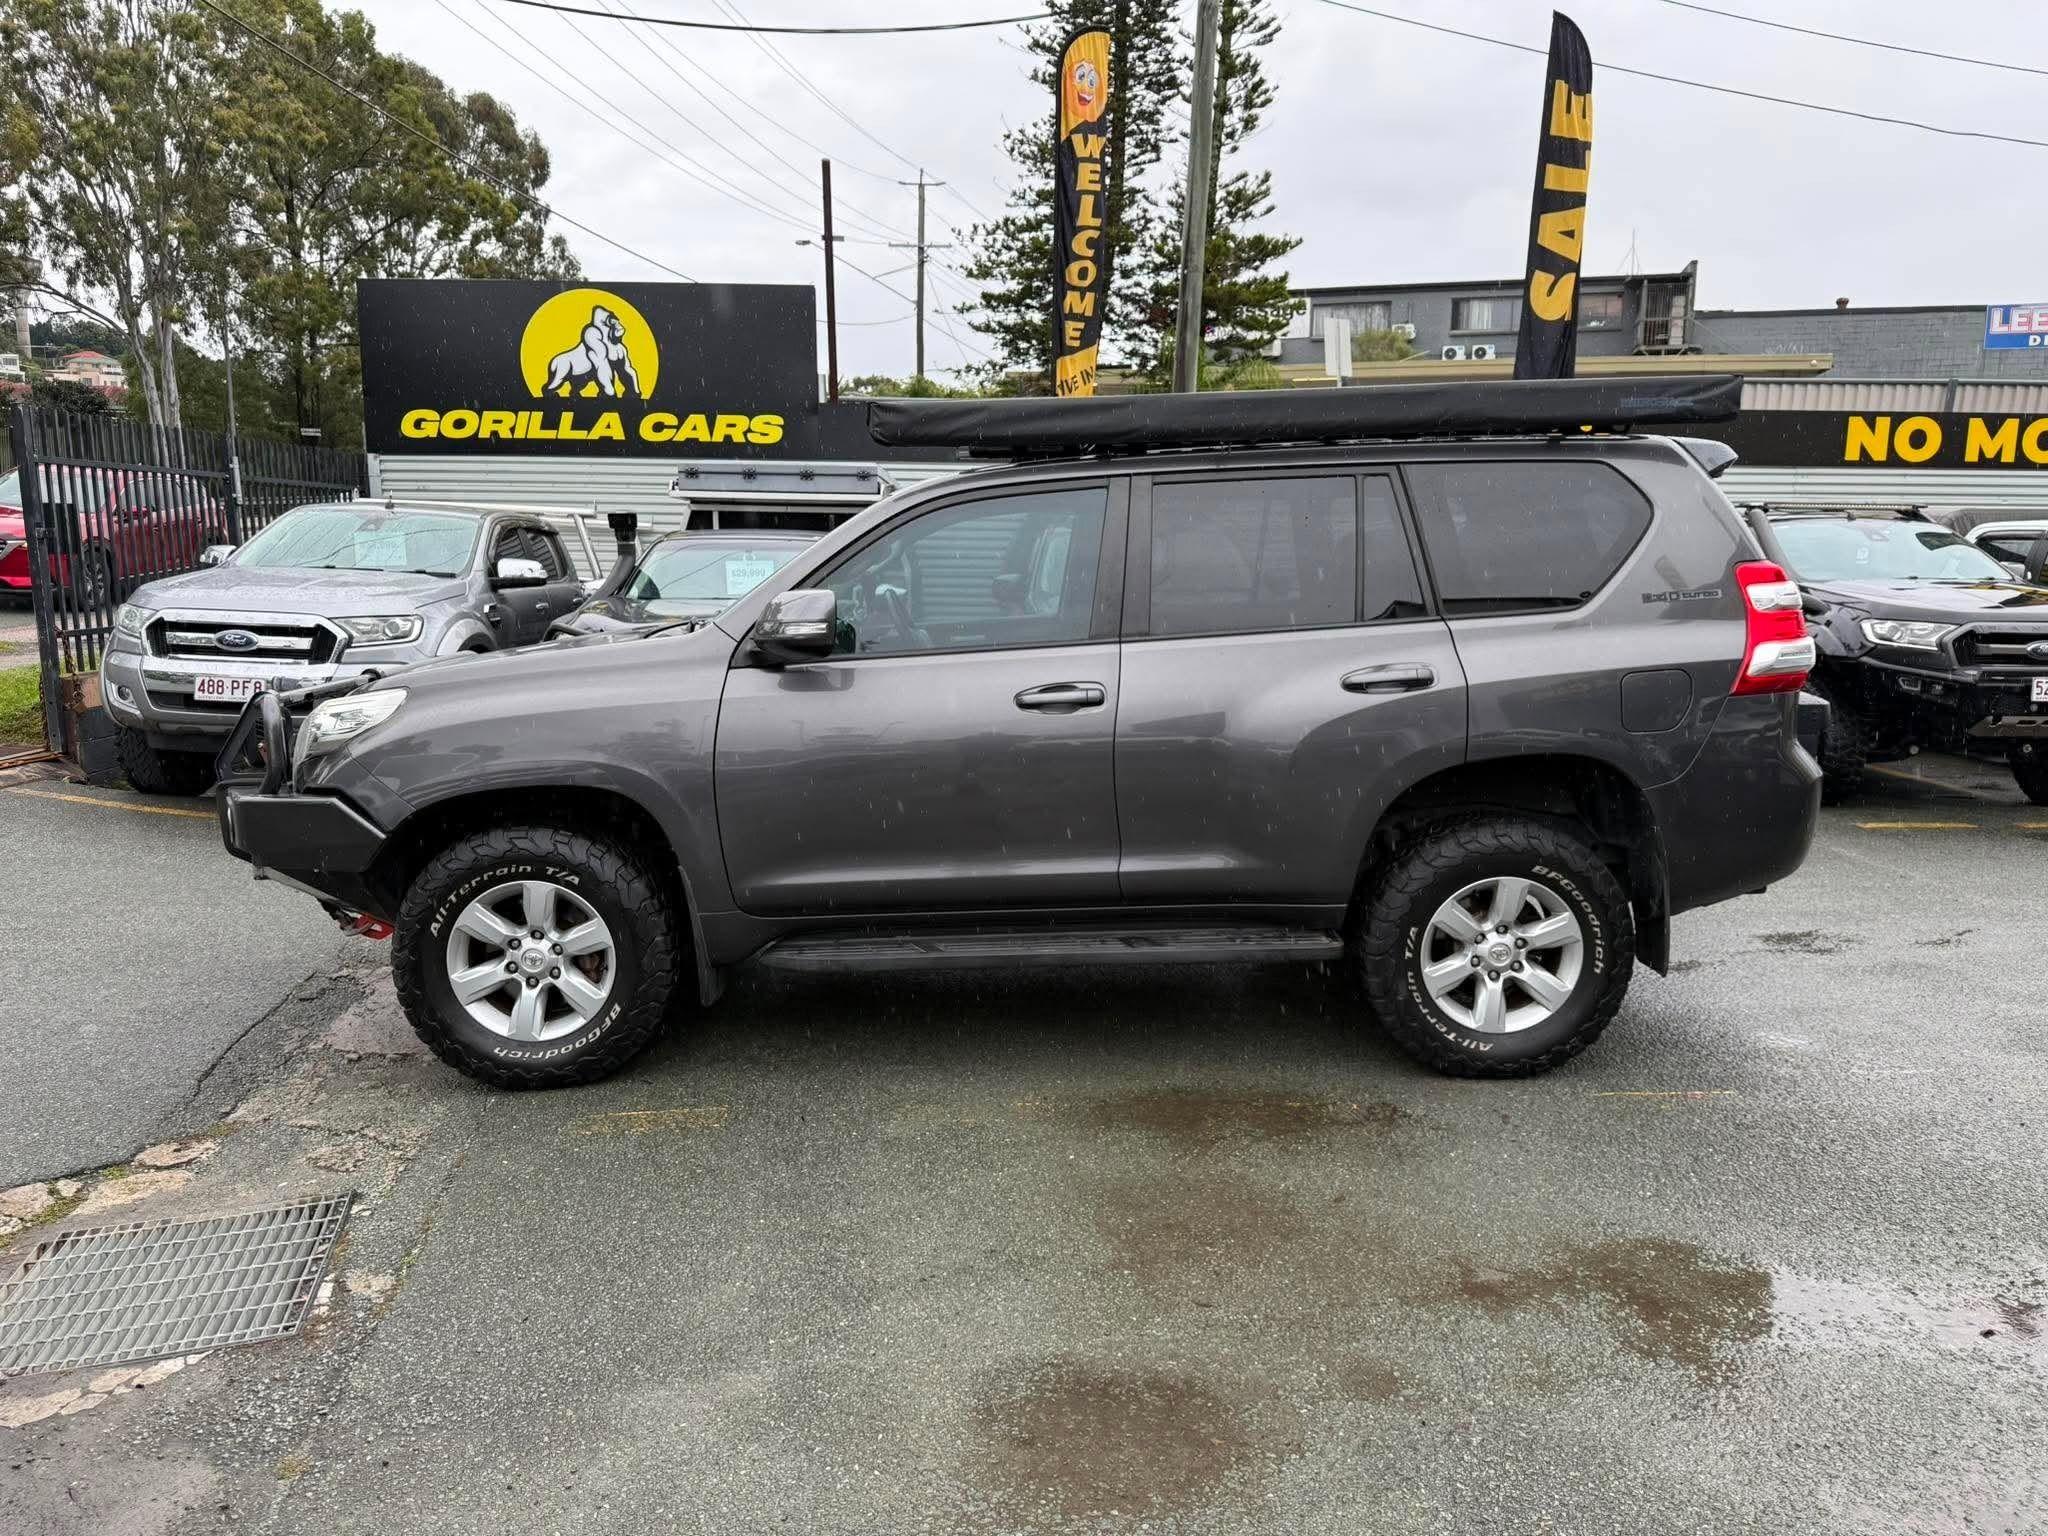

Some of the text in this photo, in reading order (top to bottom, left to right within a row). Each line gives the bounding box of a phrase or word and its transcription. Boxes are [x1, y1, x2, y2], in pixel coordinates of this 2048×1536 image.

[1530, 79, 1594, 322] SALE
[1064, 132, 1106, 348] WELCOME
[400, 409, 785, 444] GORILLA CARS
[1844, 415, 1943, 463] NO
[545, 865, 581, 886] T/A
[1531, 864, 1605, 974] BFGoodrich
[493, 1001, 623, 1060] BFGoodrich
